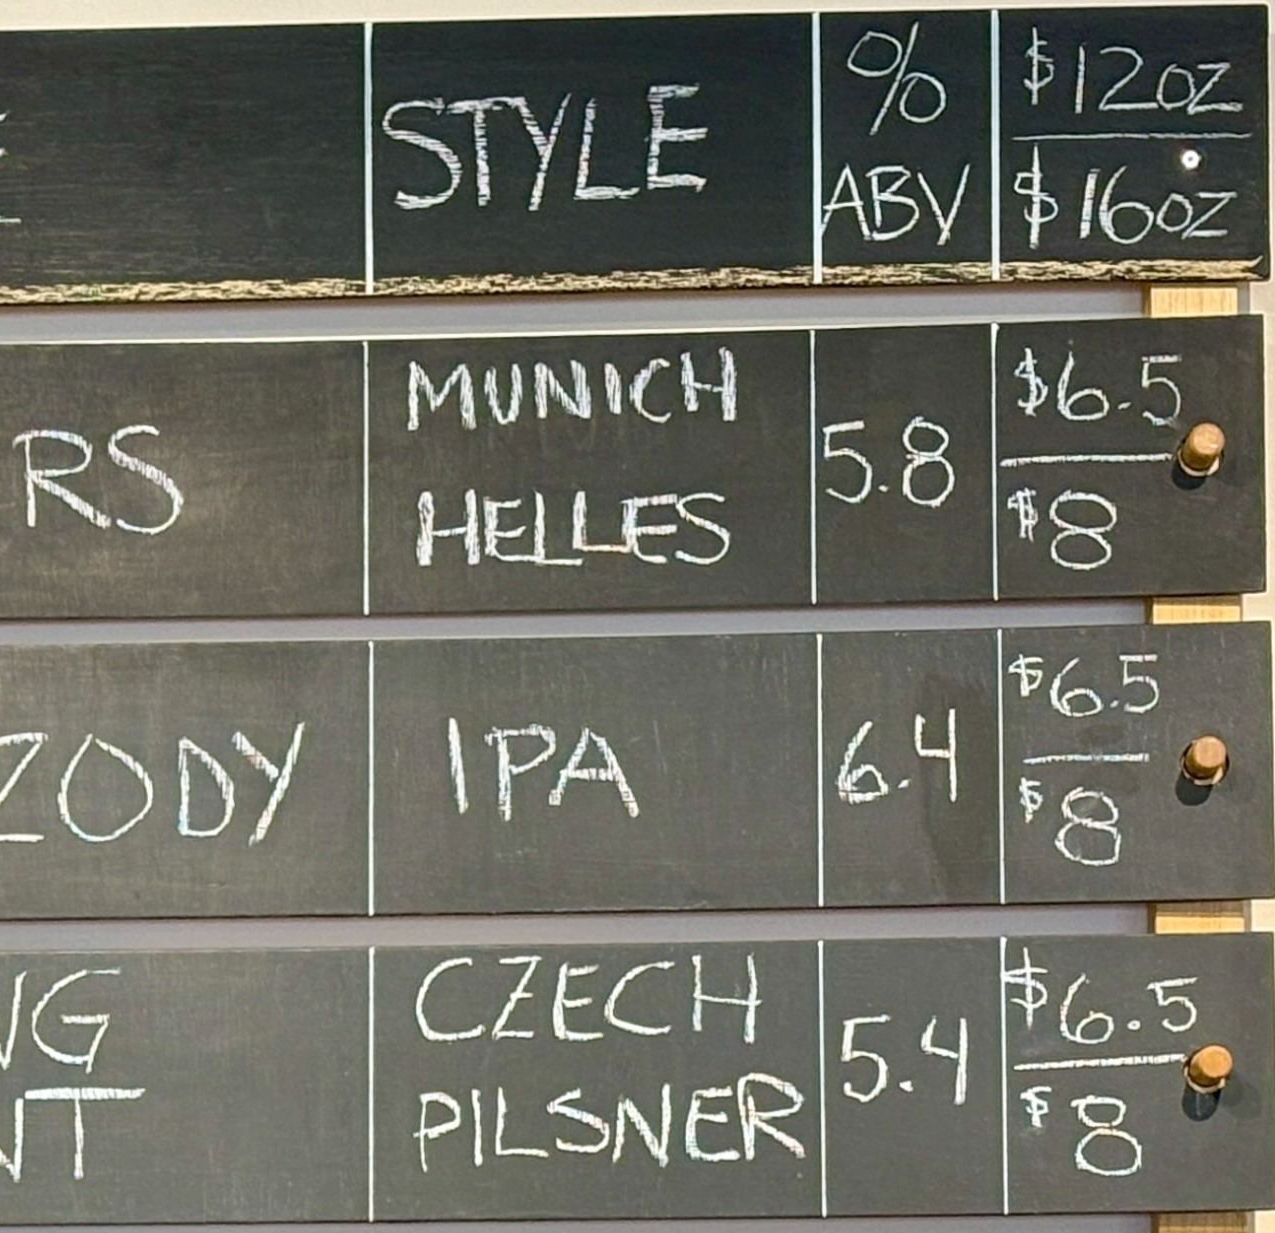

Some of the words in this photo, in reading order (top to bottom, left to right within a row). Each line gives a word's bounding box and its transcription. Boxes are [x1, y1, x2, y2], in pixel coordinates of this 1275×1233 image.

[846, 22, 947, 136] %
[382, 84, 709, 212] STYLE
[822, 165, 972, 245] ABV
[407, 348, 739, 432] MUNICH
[1014, 349, 1183, 424] $6.5
[824, 416, 956, 507] 5.8
[416, 491, 731, 566] HELLES
[1006, 489, 1118, 570] $8
[1008, 653, 1159, 717] $6.5
[449, 718, 640, 819] IPA
[838, 708, 957, 803] 6.4
[1019, 777, 1122, 865] $8
[415, 952, 762, 1044] CZECH
[1004, 948, 1198, 1046] $6.5
[840, 1014, 970, 1105] 5.4
[413, 1072, 806, 1173] PILSNER
[1021, 1086, 1142, 1177] $8
